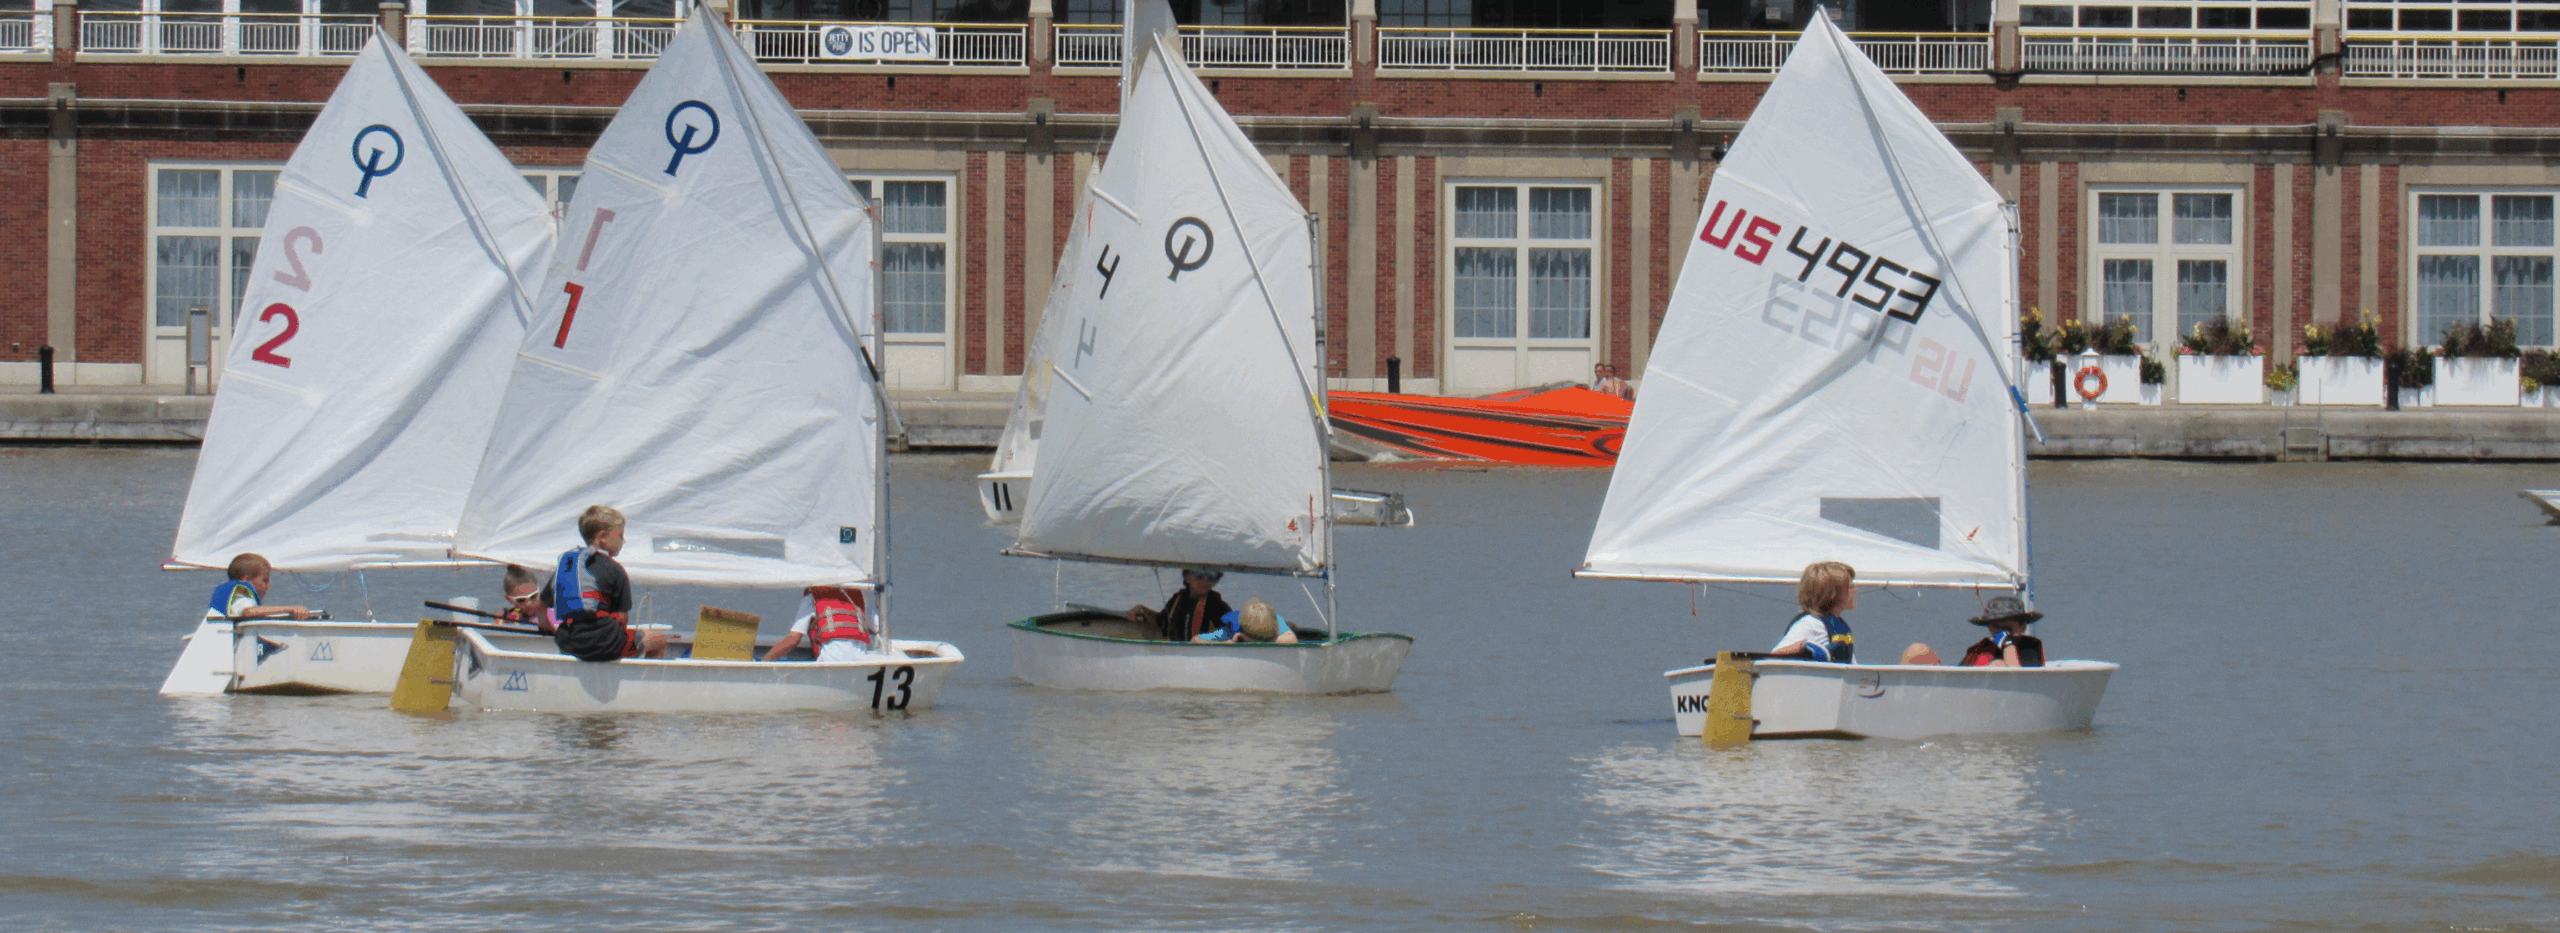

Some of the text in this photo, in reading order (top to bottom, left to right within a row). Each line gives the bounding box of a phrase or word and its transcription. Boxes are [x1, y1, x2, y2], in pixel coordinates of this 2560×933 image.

[858, 31, 875, 53] IS
[881, 31, 931, 54] OPEN
[1096, 243, 1120, 300] 4
[1700, 199, 1942, 325] US 4953
[252, 302, 300, 368] 2
[553, 281, 585, 349] 1
[992, 481, 1013, 511] 11
[867, 664, 915, 711] 13
